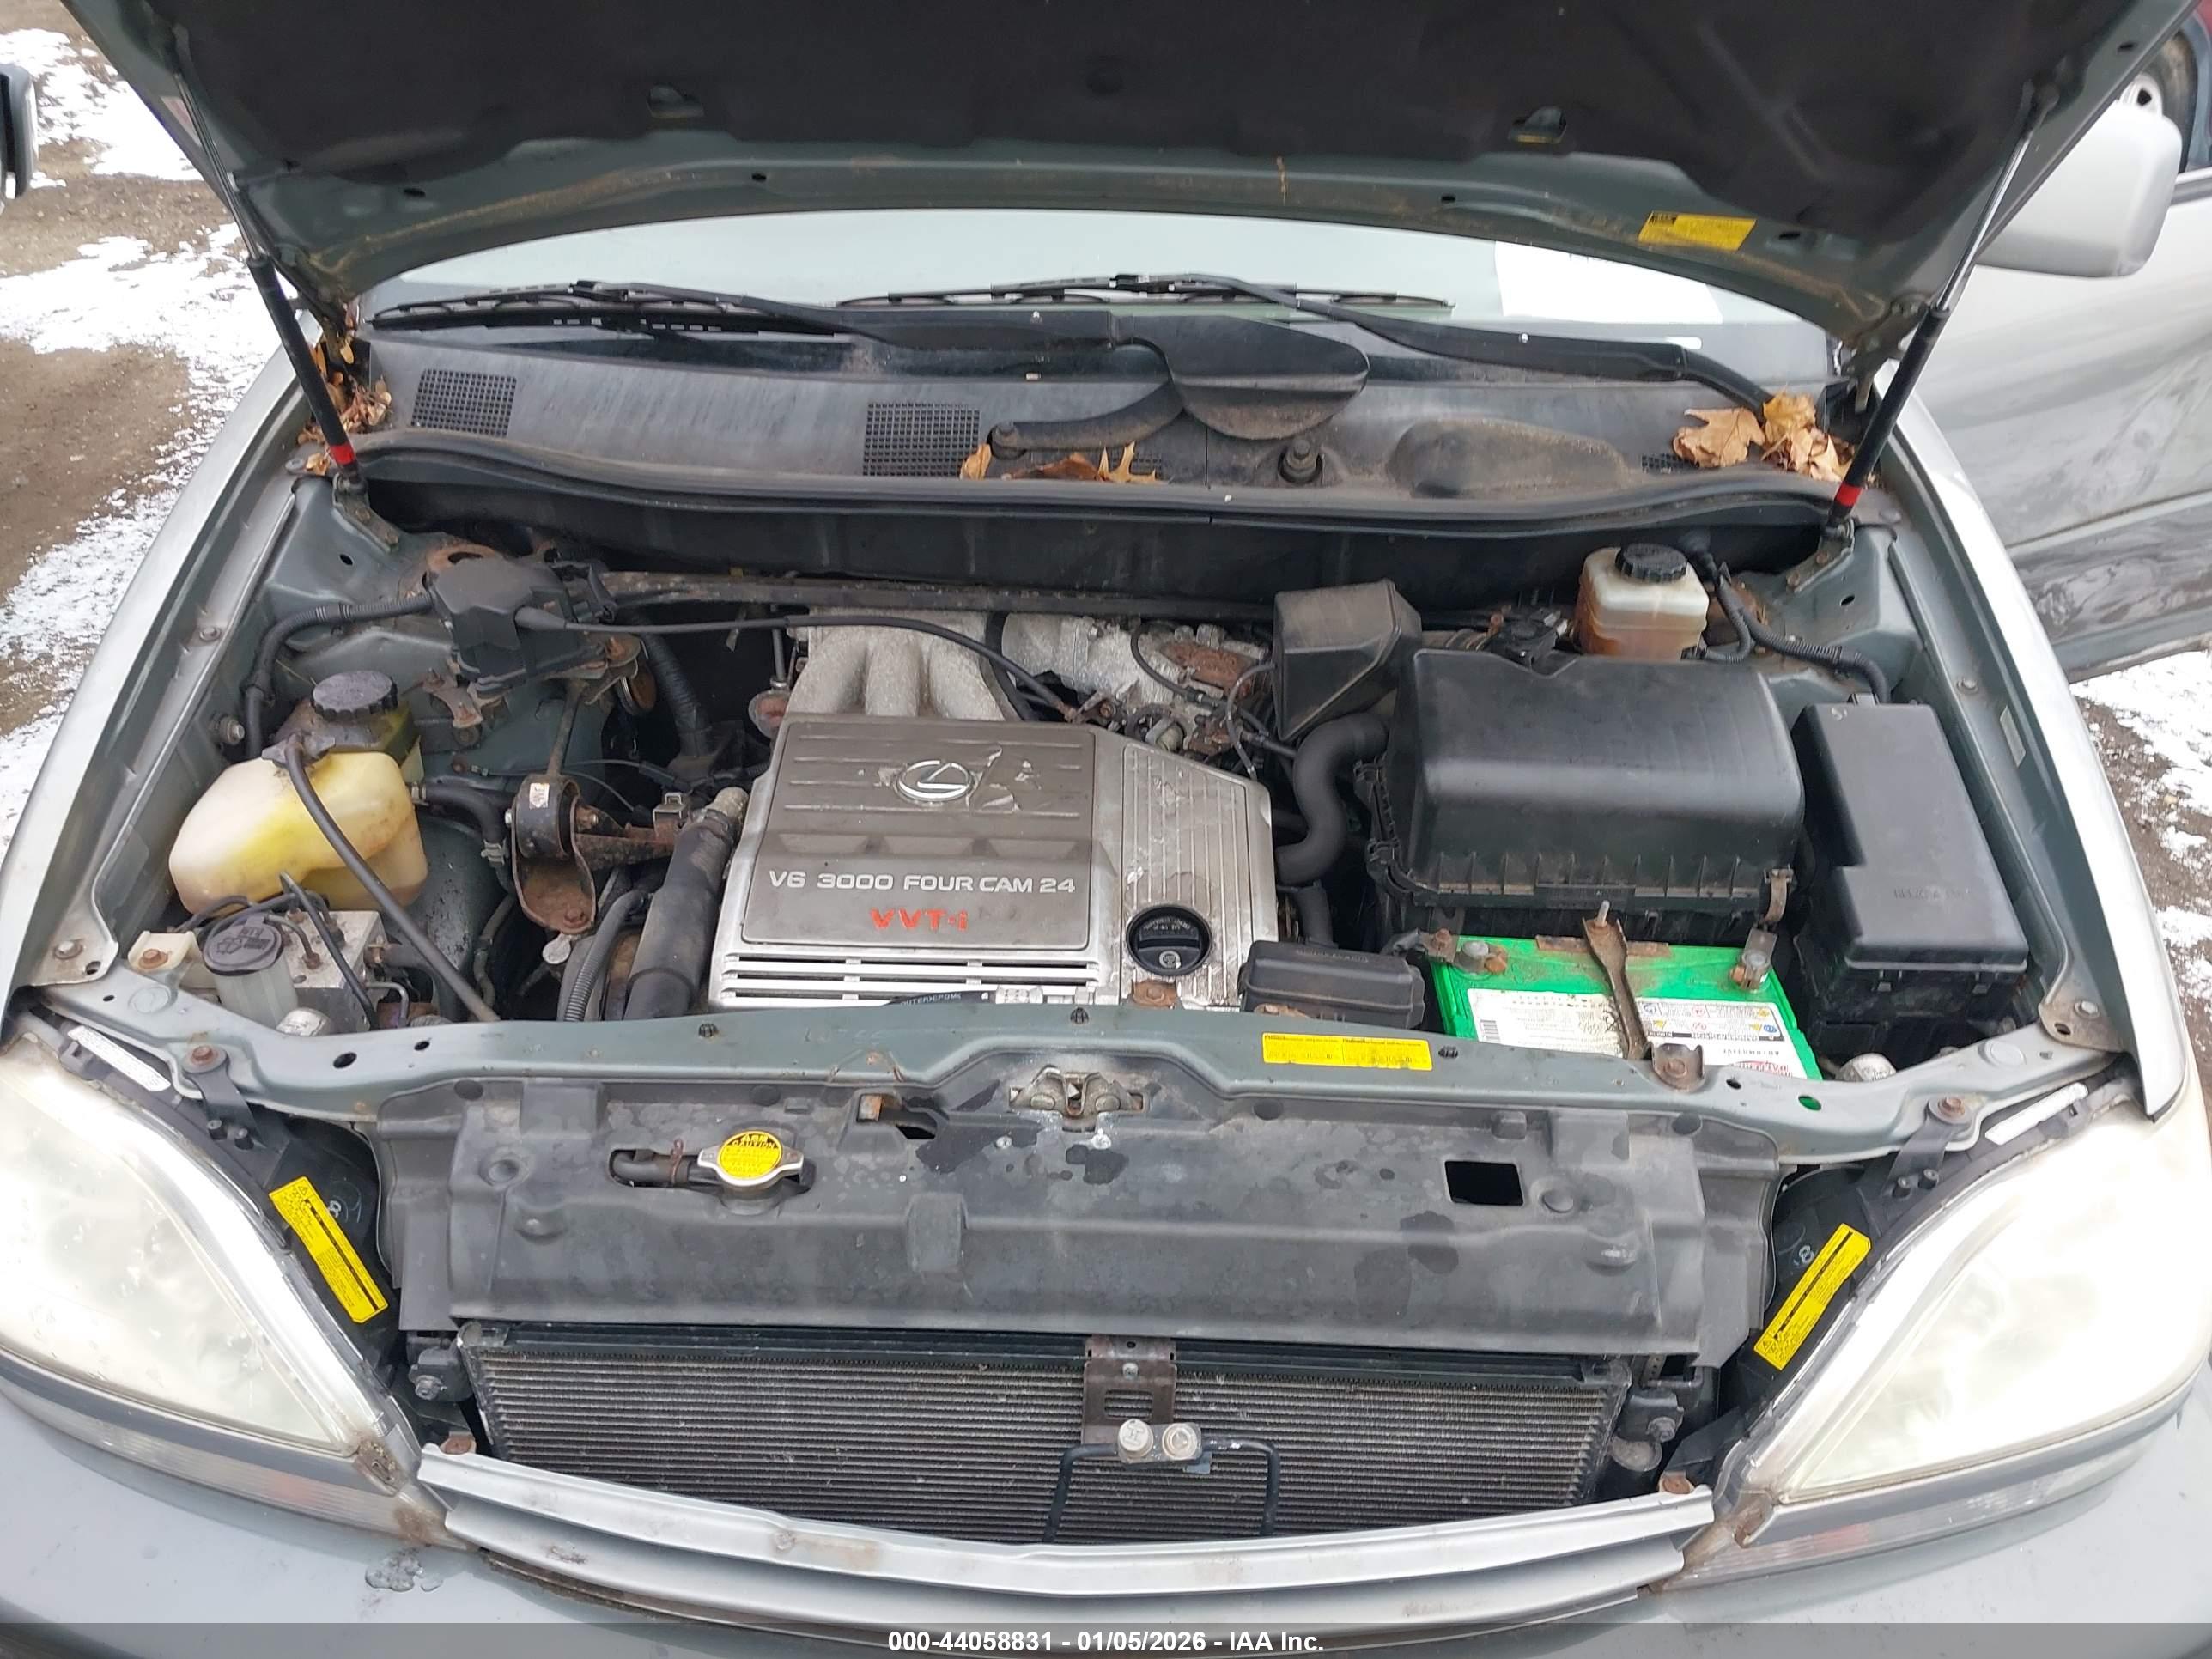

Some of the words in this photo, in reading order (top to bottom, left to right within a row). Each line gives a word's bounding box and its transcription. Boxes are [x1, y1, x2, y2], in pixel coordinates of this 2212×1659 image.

[769, 870, 806, 889] V6
[817, 872, 894, 890] 3000
[903, 874, 974, 892] FOUR
[979, 877, 1033, 894] CAM
[1039, 878, 1076, 893] 24
[732, 1139, 775, 1149] CAUTION
